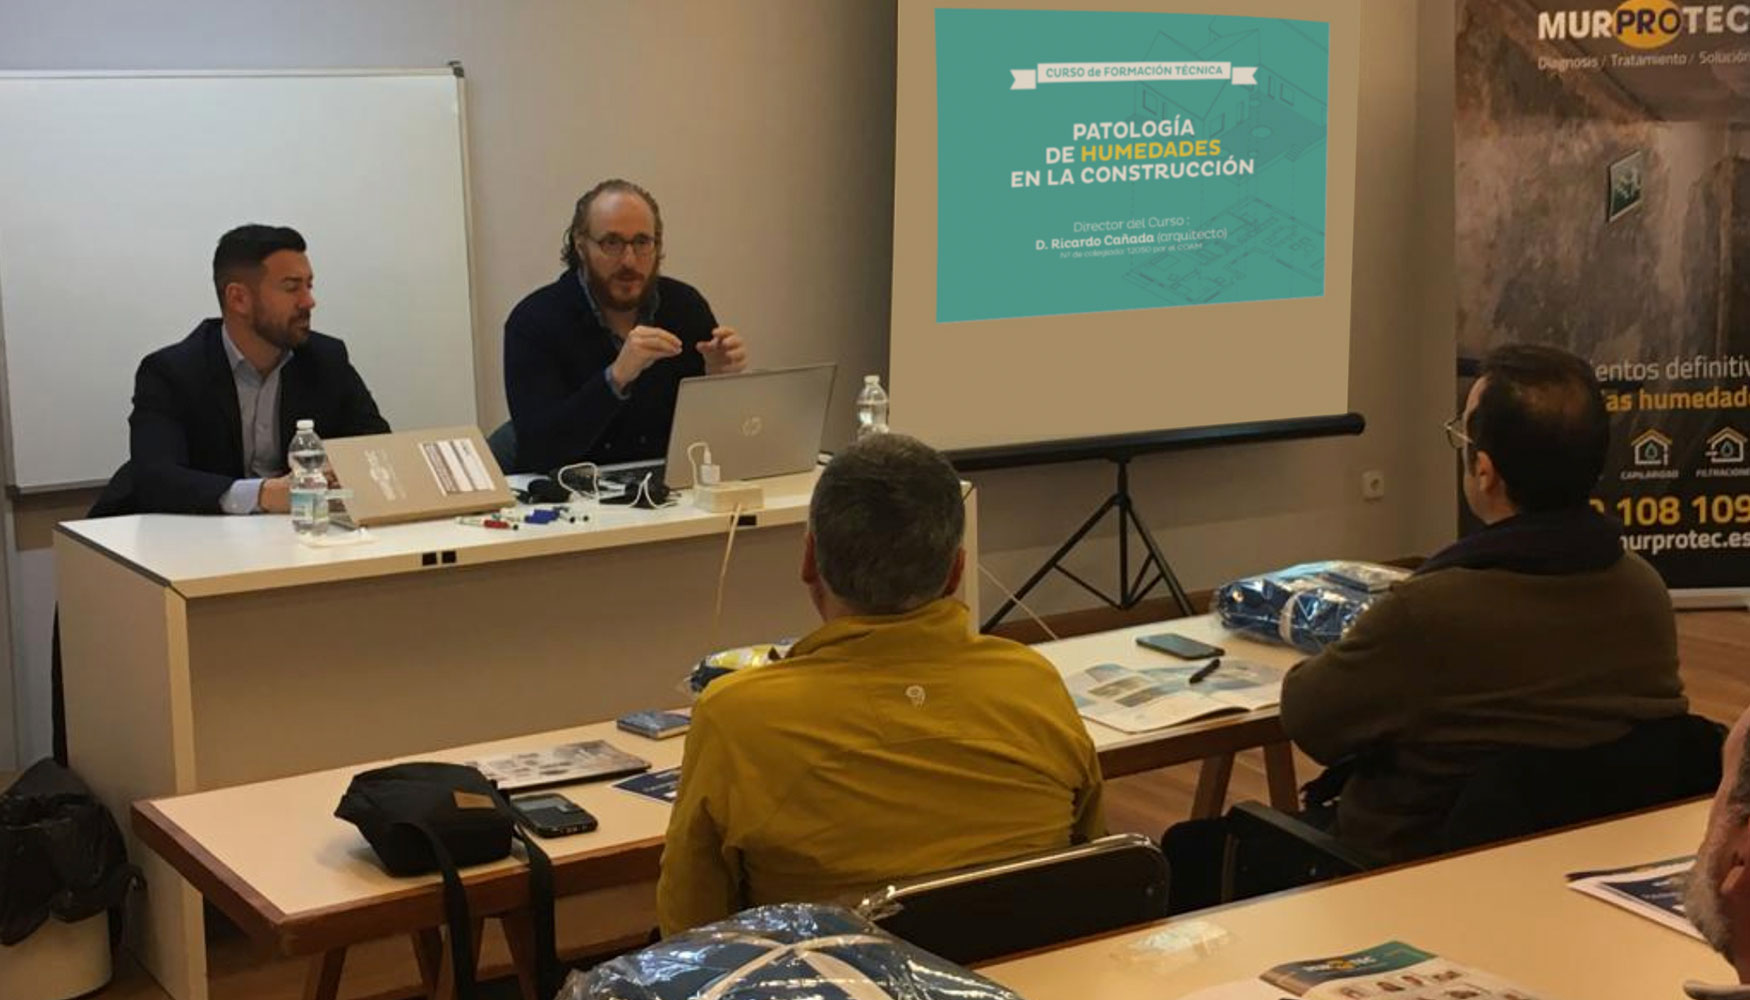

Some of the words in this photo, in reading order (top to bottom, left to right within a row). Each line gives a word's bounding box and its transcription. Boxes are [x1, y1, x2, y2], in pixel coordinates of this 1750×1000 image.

[1538, 3, 1750, 40] MURPROTEC
[1045, 66, 1086, 79] CURSO
[1087, 65, 1102, 77] de
[1103, 63, 1173, 77] FORMACIÓN
[1175, 62, 1224, 76] TÉCNICA
[1537, 55, 1599, 71] Diagnosis
[1610, 52, 1688, 68] Tratamiento
[1073, 114, 1196, 141] PATOLOGÍA
[1045, 146, 1075, 164] DE
[1081, 138, 1222, 163] HUMEDADES
[1011, 169, 1040, 188] EN
[1047, 168, 1075, 186] LA
[1080, 154, 1255, 184] CONSTRUCCIÓN
[1073, 219, 1124, 233] Director
[1126, 217, 1146, 230] del
[1035, 239, 1049, 251] D.
[1051, 235, 1101, 250] Ricardo
[1103, 232, 1154, 247] Cañada
[1156, 227, 1228, 245] (arquitecto)
[1590, 358, 1660, 383] entos
[1602, 387, 1633, 413] as
[1639, 385, 1750, 411] humedad
[1617, 495, 1681, 527] 108
[1691, 493, 1750, 525] 109
